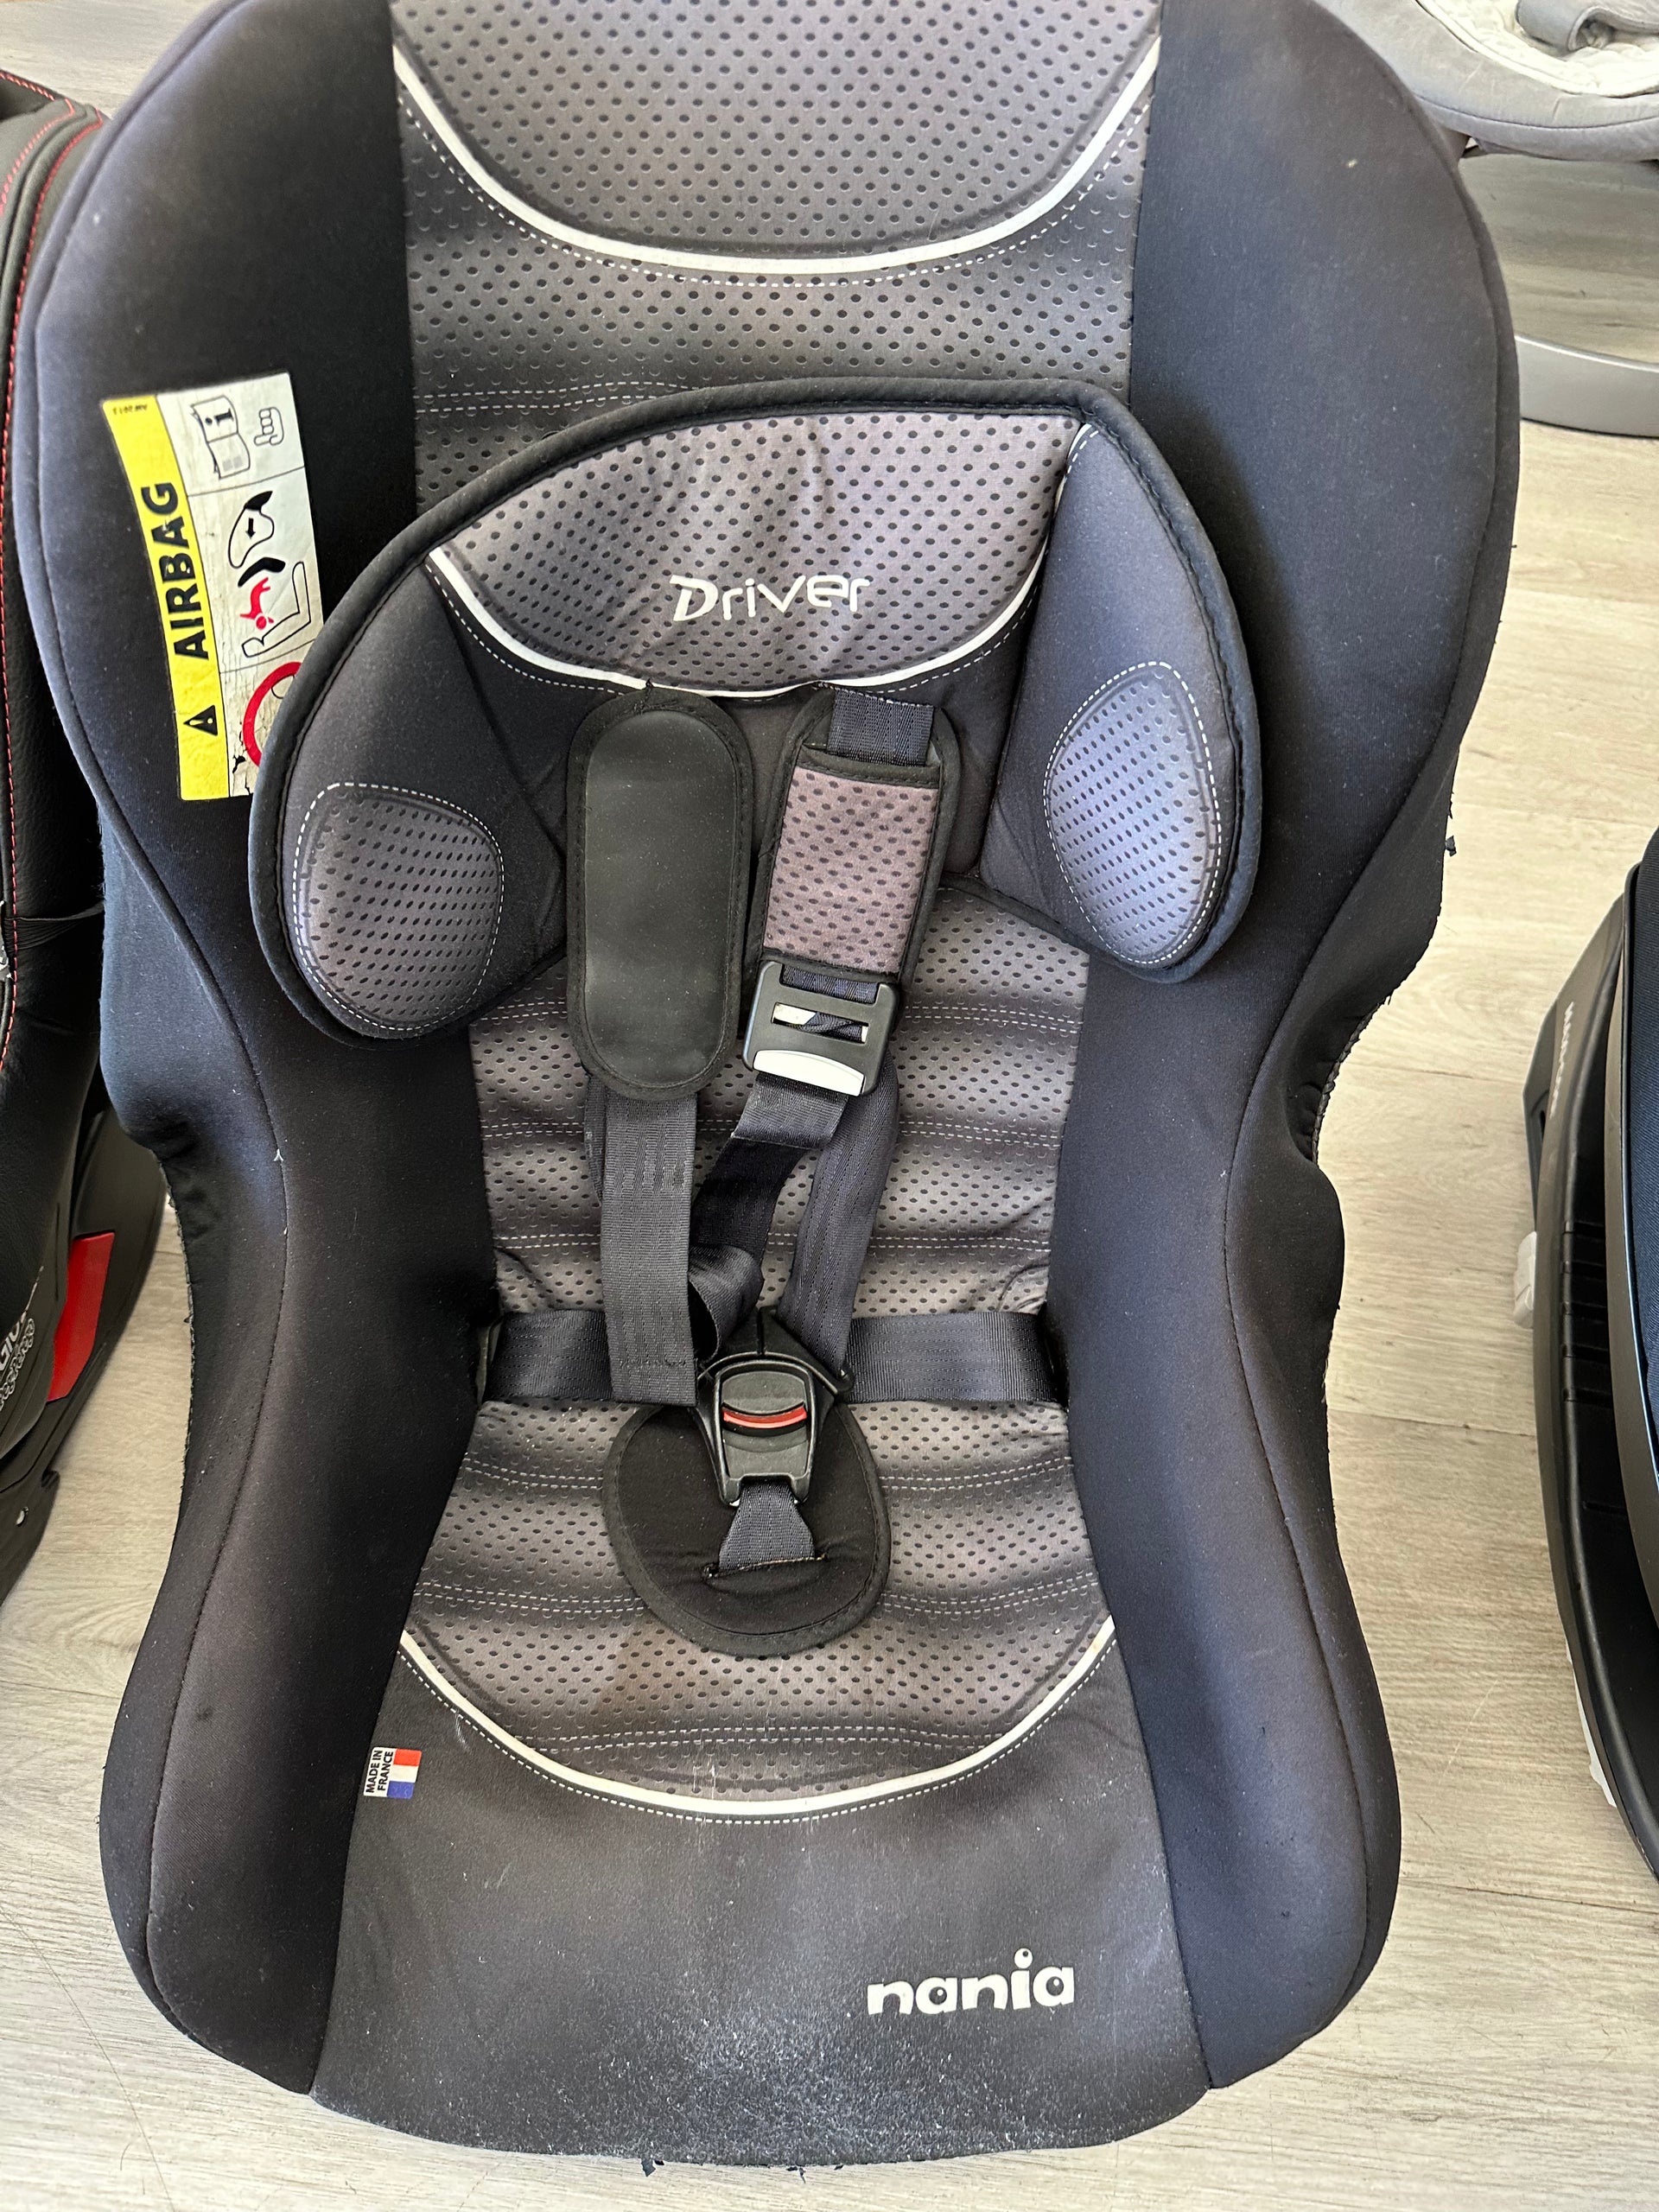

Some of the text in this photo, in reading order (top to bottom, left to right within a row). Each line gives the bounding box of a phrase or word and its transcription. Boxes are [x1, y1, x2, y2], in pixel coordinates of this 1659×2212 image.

[141, 481, 209, 661] AIRBAG
[670, 575, 870, 621] Driver
[365, 1750, 383, 1793] MADE IN
[378, 1751, 393, 1791] FRANCE
[867, 1948, 1074, 2015] nania
